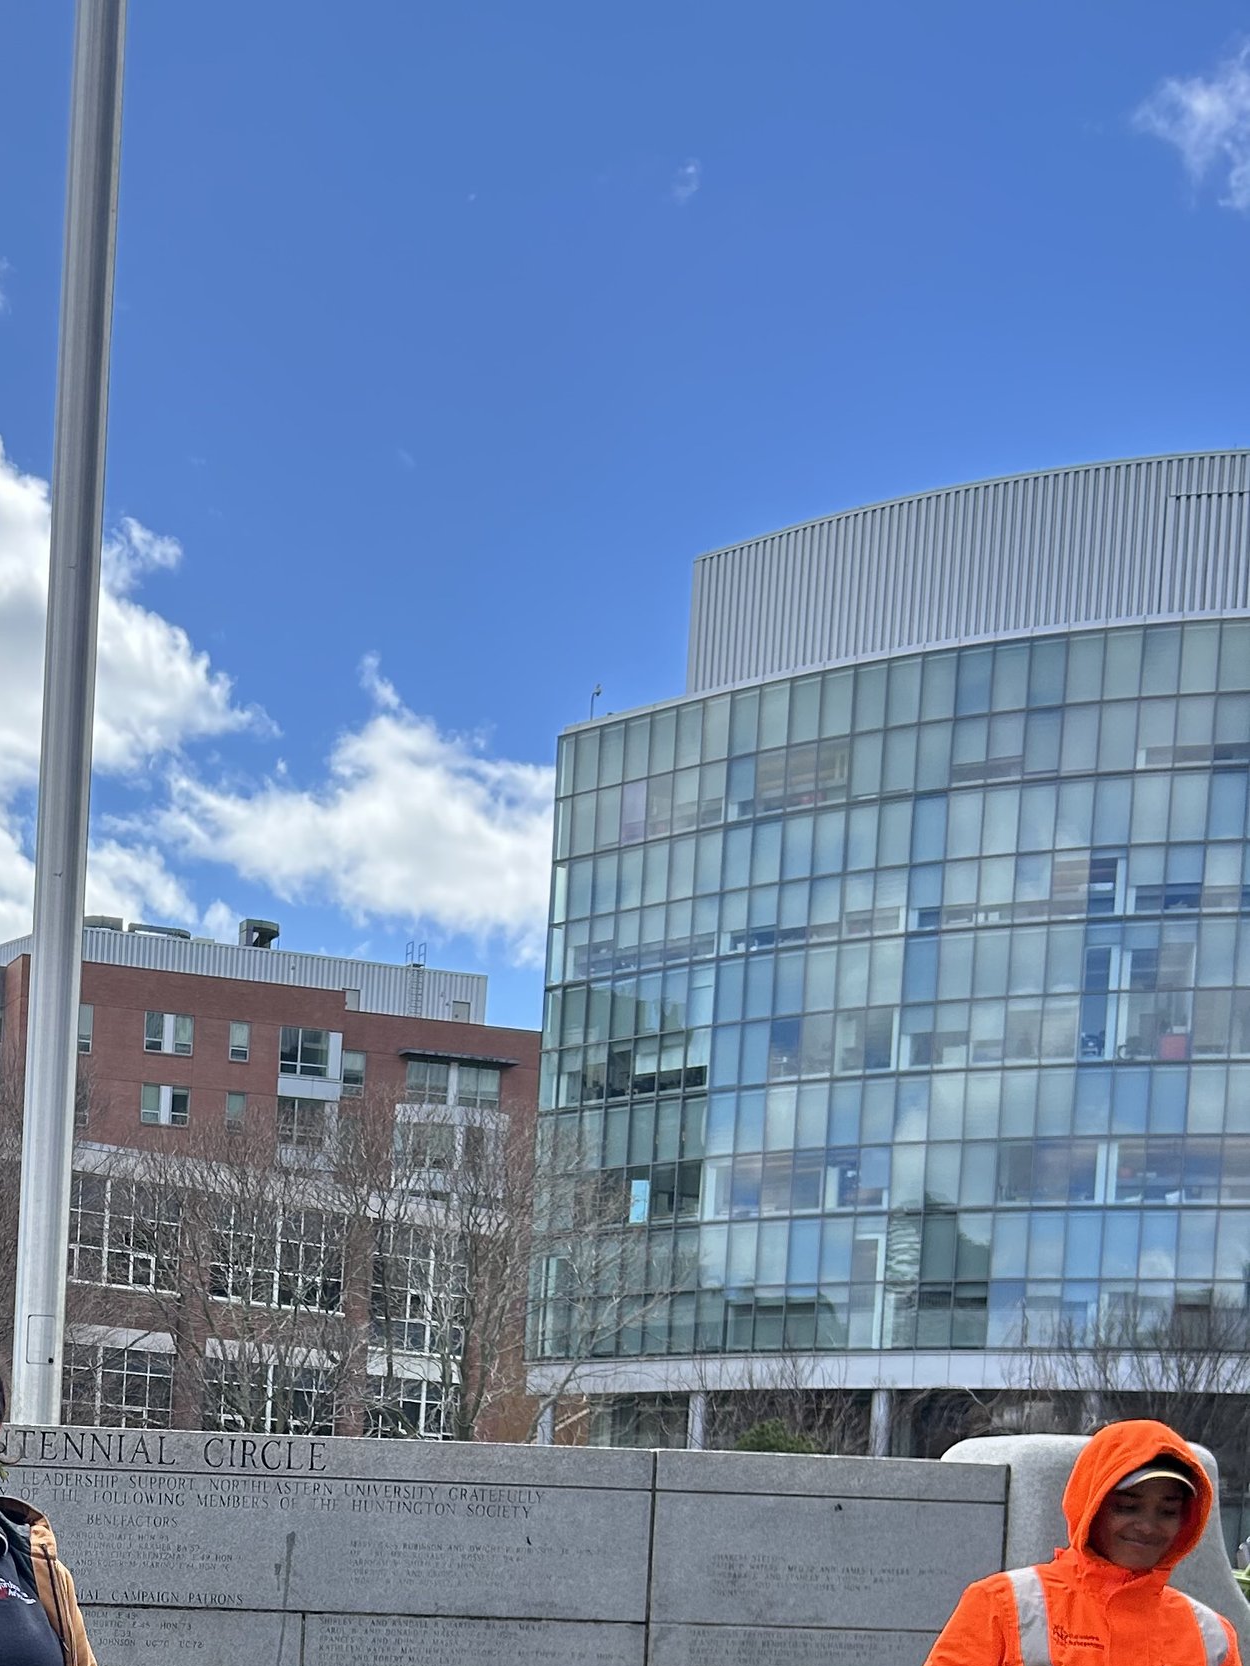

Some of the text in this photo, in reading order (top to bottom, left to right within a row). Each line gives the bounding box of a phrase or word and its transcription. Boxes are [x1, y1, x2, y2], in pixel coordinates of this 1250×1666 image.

[203, 1437, 327, 1471] CIRCLE
[22, 1471, 119, 1488] LEADERSHIP
[209, 1478, 334, 1495] NORTHEASTERN
[344, 1483, 438, 1500] UNIVERSITY
[448, 1487, 547, 1504] GRATEFULLY
[20, 1487, 39, 1501] OF
[51, 1488, 79, 1503] THE
[93, 1490, 186, 1507] FOLLOWING
[196, 1494, 269, 1510] MEMBERS
[279, 1496, 298, 1511] OF
[310, 1498, 340, 1513] THE
[351, 1499, 457, 1516] HUNTINGTON
[467, 1503, 533, 1519] SOCIETY
[86, 1513, 179, 1528] BENEFACTORS
[111, 1589, 180, 1604] CAMPAIGN
[187, 1592, 244, 1606] PATRONS
[371, 1619, 387, 1627] AND
[97, 1637, 136, 1646] JOHNSON
